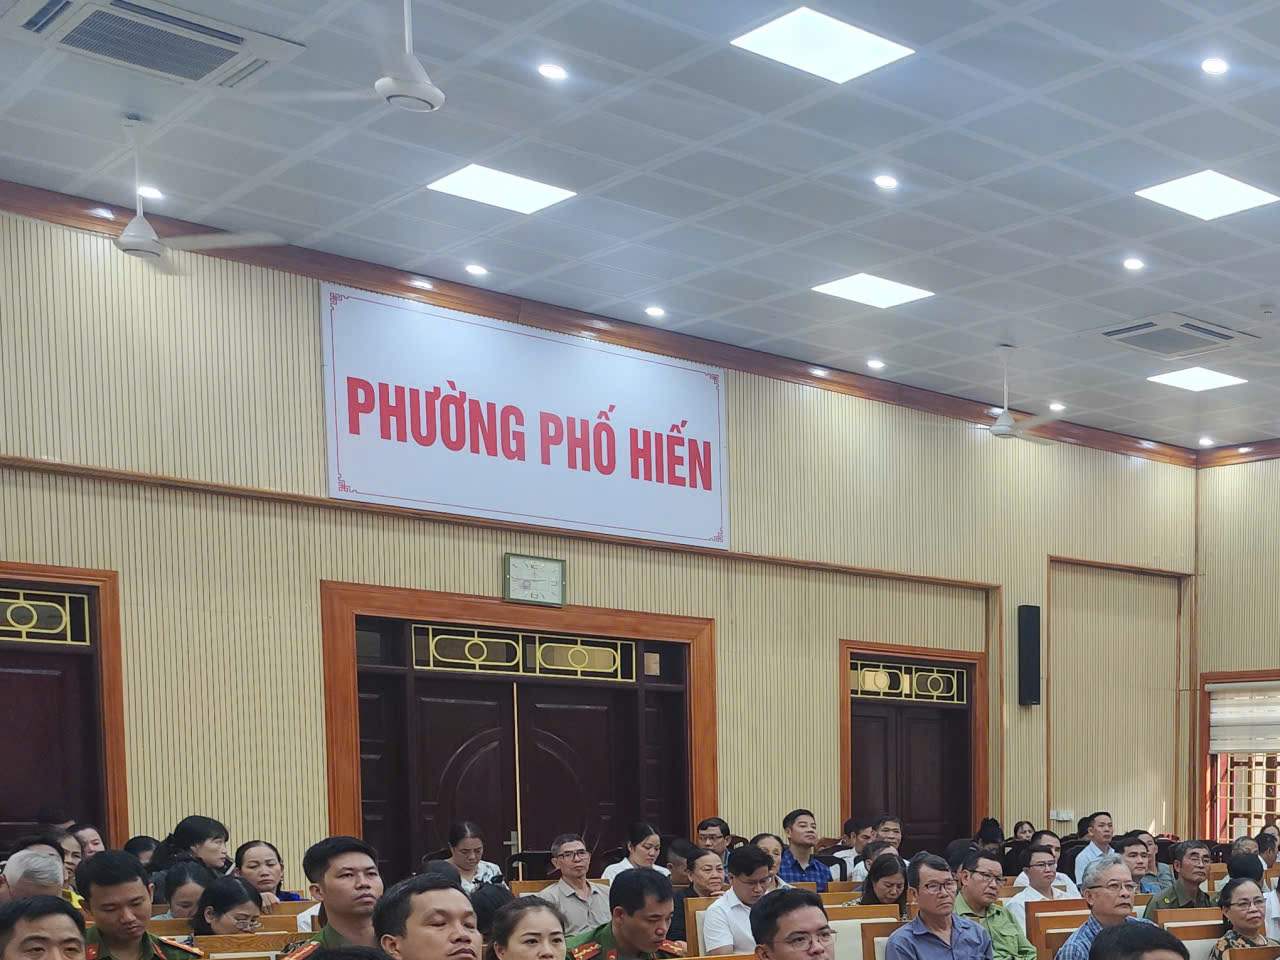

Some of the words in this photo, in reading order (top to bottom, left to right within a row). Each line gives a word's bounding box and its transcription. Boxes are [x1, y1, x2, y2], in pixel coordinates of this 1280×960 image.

[346, 376, 526, 461] PHƯỜNG
[539, 404, 616, 476] PHỐ
[629, 420, 713, 491] HIẾN
